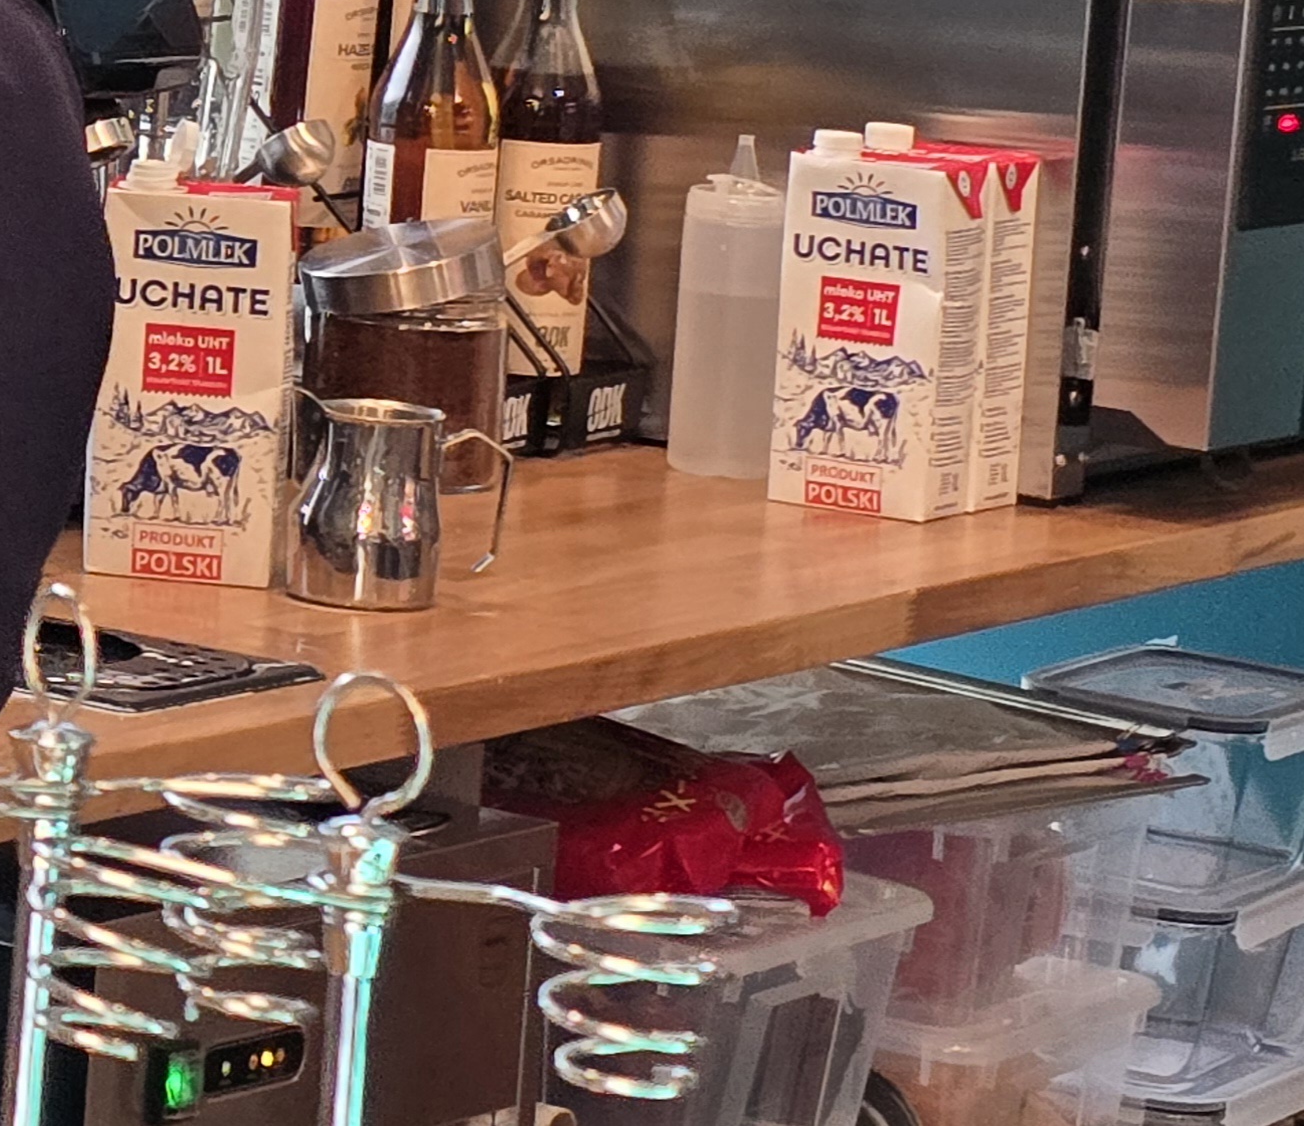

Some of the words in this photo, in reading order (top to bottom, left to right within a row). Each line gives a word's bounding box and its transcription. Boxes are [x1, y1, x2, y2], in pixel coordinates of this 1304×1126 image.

[505, 188, 557, 205] SALTED
[814, 194, 913, 227] POLMLEK
[137, 233, 253, 265] POLMLEK
[793, 233, 930, 275] UCHATE
[116, 276, 271, 317] UCHATE
[823, 284, 865, 301] mleko
[867, 288, 896, 304] UHT
[823, 302, 865, 324] 3,2%
[873, 310, 893, 326] 1L
[148, 332, 195, 348] mleko
[198, 335, 230, 351] UHT
[148, 351, 197, 374] 3,2%
[205, 356, 229, 375] 1L
[503, 393, 532, 440] DK
[586, 383, 627, 432] ODK
[810, 464, 877, 484] PRODUKT
[807, 483, 879, 511] POLSKI
[139, 530, 217, 549] PRODUKT
[134, 551, 220, 578] POLSKI
